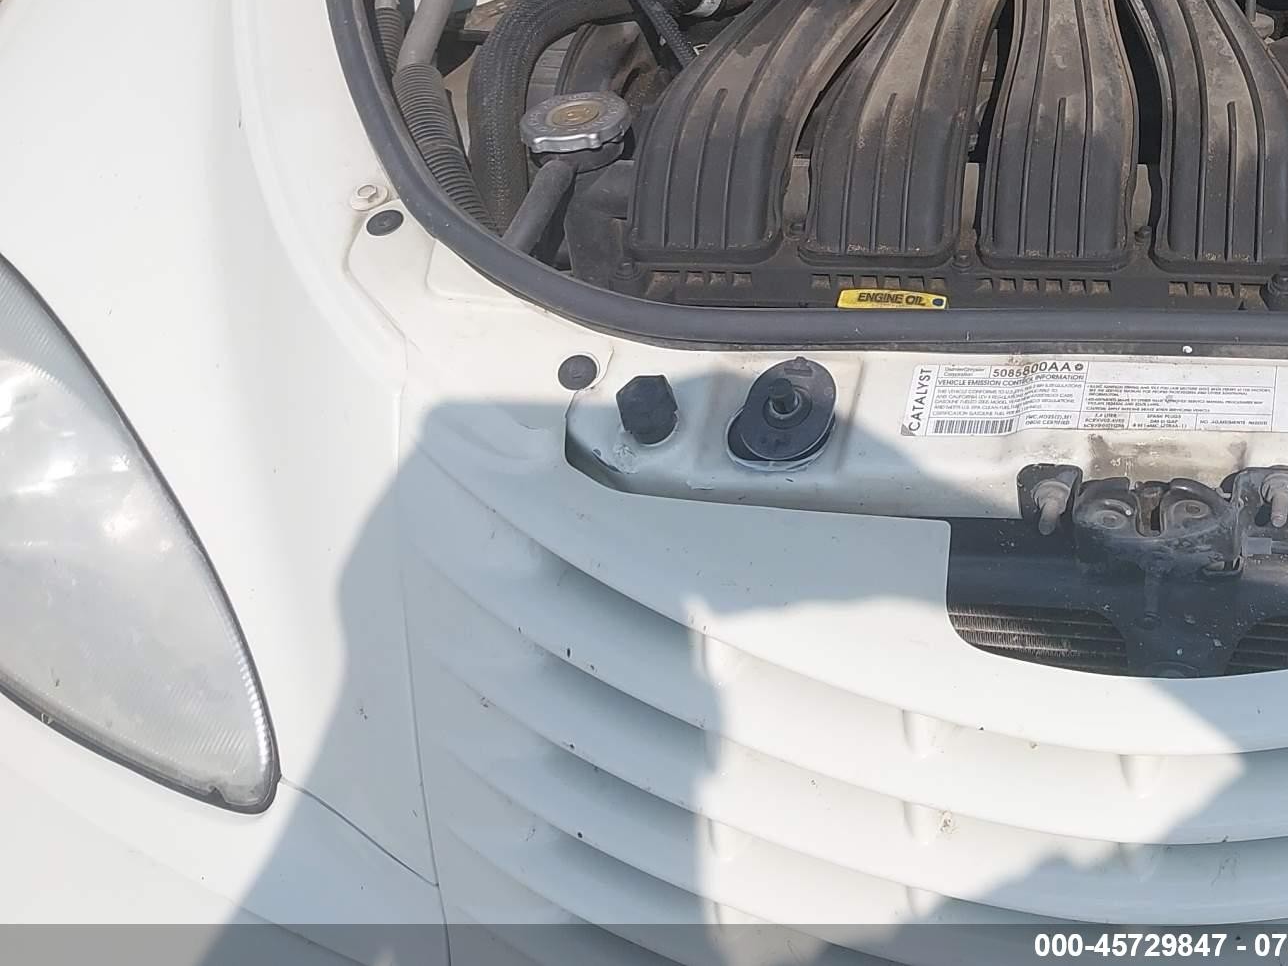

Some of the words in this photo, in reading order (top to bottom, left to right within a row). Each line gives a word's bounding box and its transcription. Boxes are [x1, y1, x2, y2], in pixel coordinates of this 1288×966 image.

[857, 292, 903, 304] ENGINE
[905, 294, 926, 306] OIL
[993, 361, 1072, 378] 5085800AA
[1034, 372, 1084, 381] INFORMATION
[908, 369, 932, 431] CATALYST
